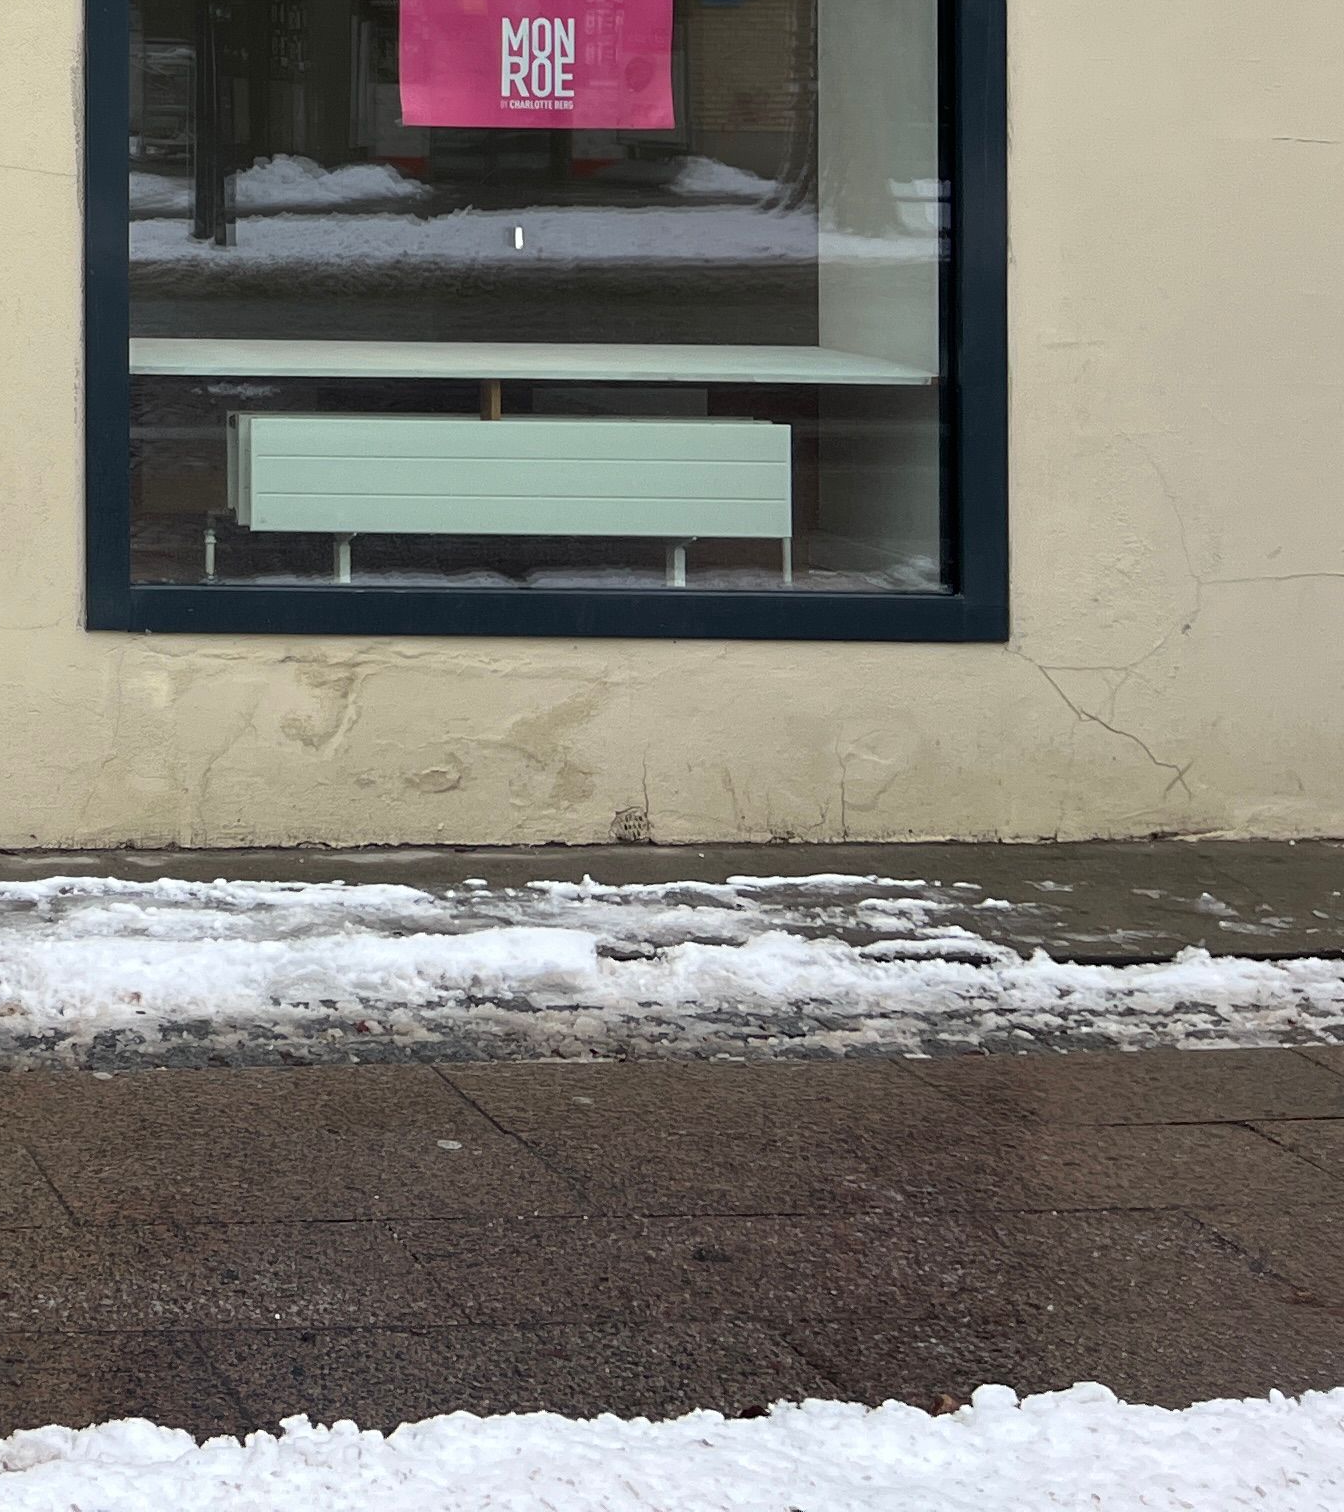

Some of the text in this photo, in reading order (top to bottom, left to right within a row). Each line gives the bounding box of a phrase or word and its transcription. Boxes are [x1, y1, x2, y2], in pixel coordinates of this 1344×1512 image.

[501, 17, 575, 63] MON
[499, 56, 575, 98] ROE
[509, 99, 553, 110] CHARLOTTE
